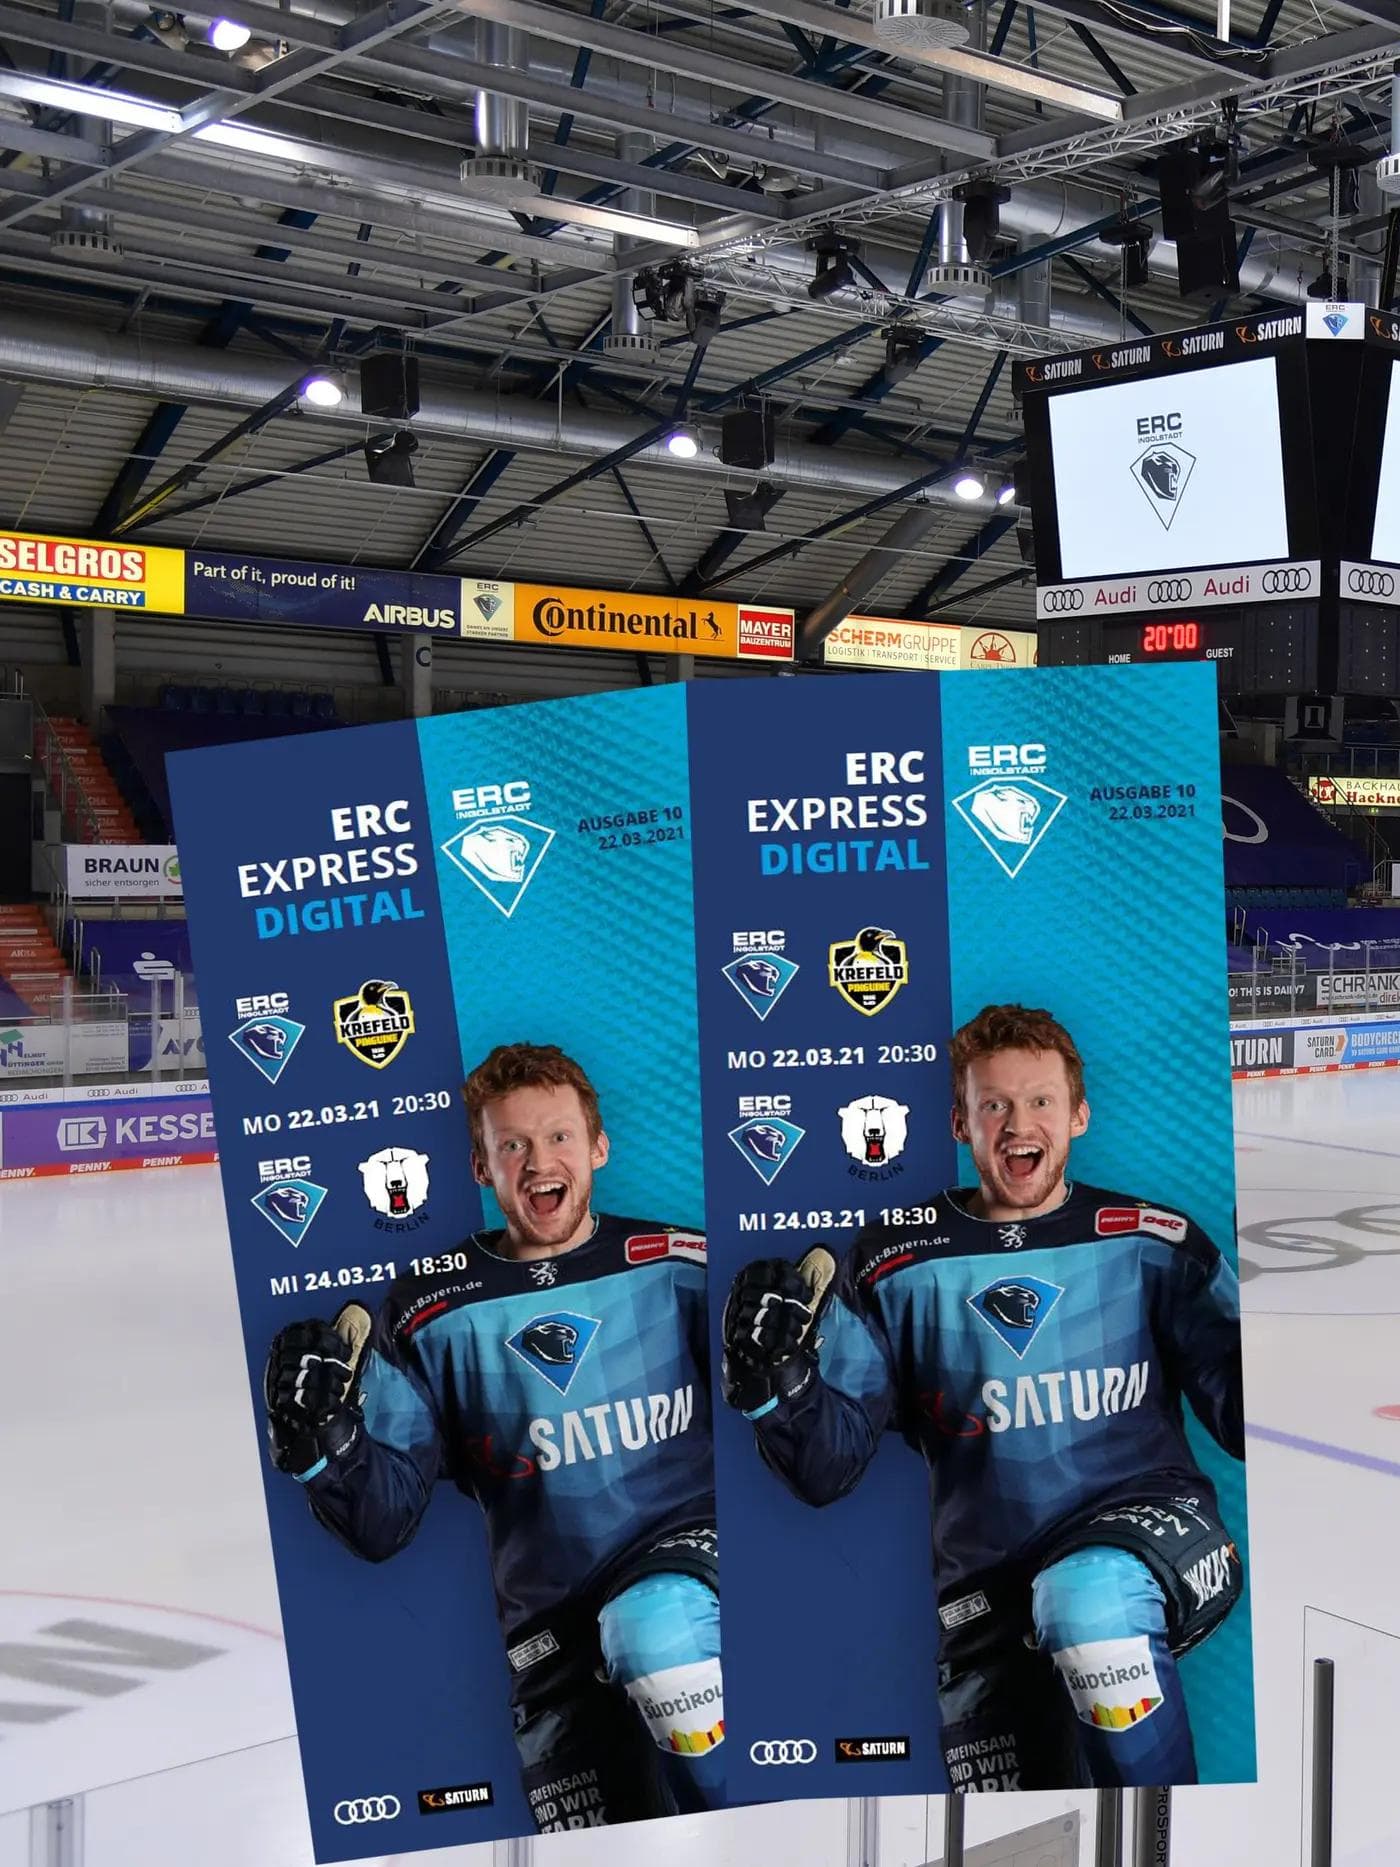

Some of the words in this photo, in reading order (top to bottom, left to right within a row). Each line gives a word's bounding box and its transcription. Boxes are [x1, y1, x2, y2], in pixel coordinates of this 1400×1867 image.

[1257, 316, 1301, 343] SATURN
[1182, 332, 1224, 355] SATURN
[1111, 345, 1151, 368] SATURN
[1044, 358, 1082, 382] SATURN
[1137, 413, 1182, 436] ERC
[1138, 430, 1183, 444] INGOLSTADT
[0, 538, 143, 581] SELGROS
[194, 562, 226, 579] Part
[230, 565, 248, 582] of
[251, 569, 266, 585] it,
[272, 571, 317, 591] proud
[321, 574, 342, 589] of
[345, 576, 356, 590] it!
[0, 581, 53, 598] CASH
[59, 585, 72, 600] &
[76, 587, 140, 605] CARRY
[1095, 585, 1137, 606] Audi
[1204, 575, 1250, 597] Audi
[363, 604, 455, 628] AIRBUS
[533, 597, 697, 639] Continental
[740, 619, 792, 638] MAYER
[740, 636, 791, 648] BAUZENTRUM
[1206, 648, 1234, 658] GUEST
[415, 646, 431, 667] C
[828, 646, 865, 657] LOGISTIK
[872, 651, 918, 661] TRANSPORT
[925, 654, 956, 665] SERVICE
[1109, 654, 1131, 663] HOME
[84, 857, 159, 873] BRAUN
[84, 877, 110, 887] sicher
[114, 878, 160, 889] entsorgen
[980, 1359, 1149, 1434] SATURN
[529, 1384, 694, 1472] SATURN
